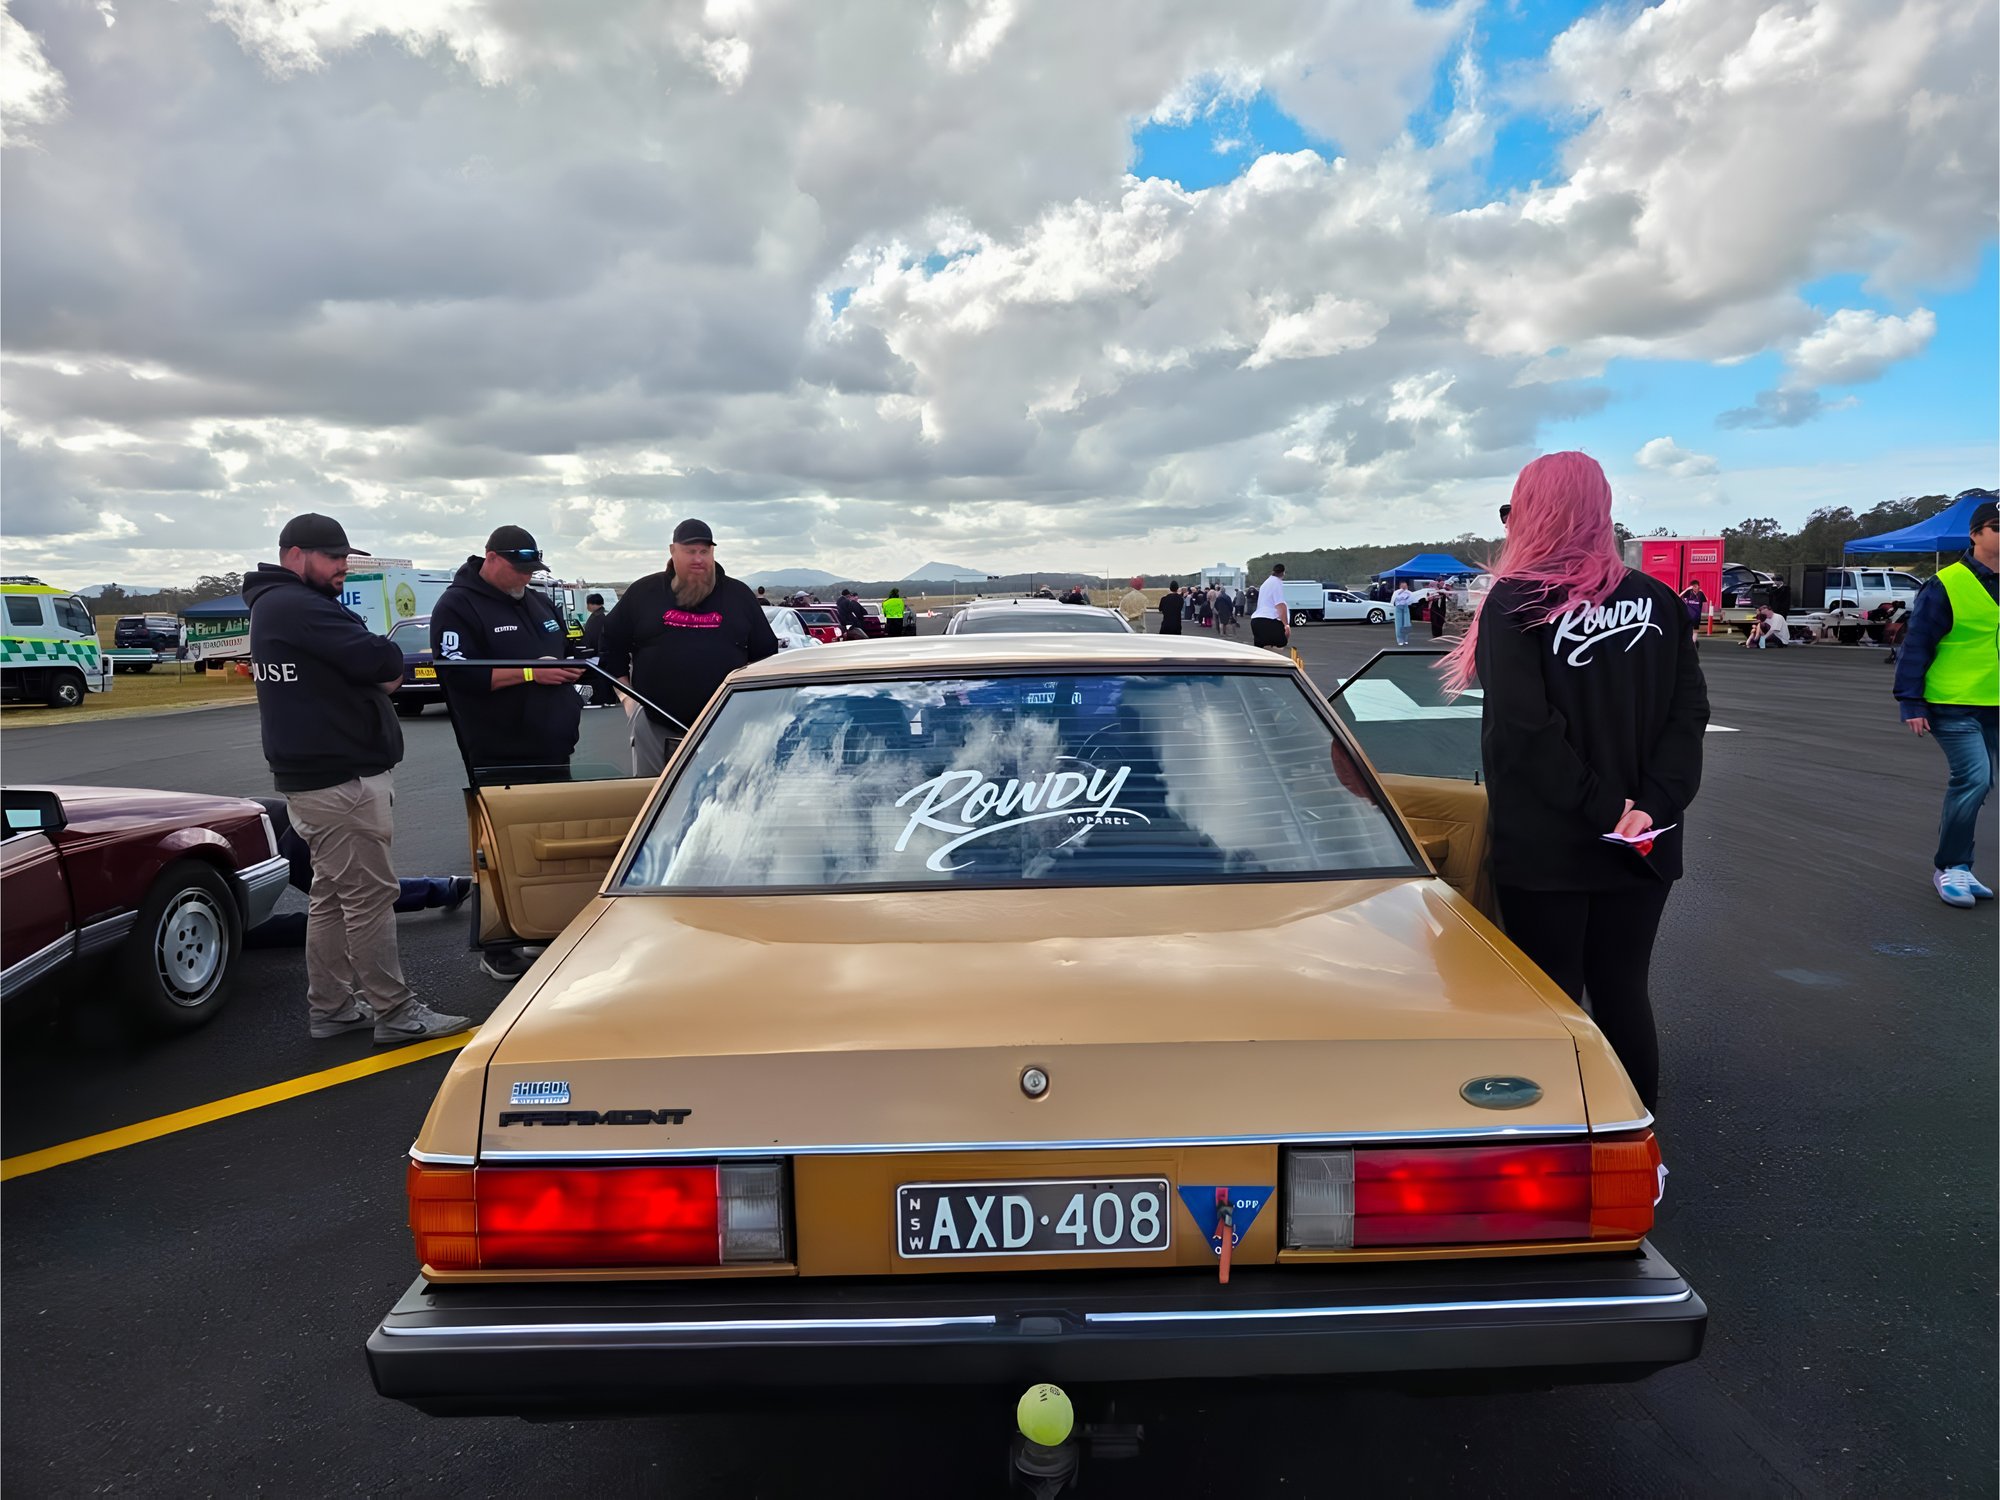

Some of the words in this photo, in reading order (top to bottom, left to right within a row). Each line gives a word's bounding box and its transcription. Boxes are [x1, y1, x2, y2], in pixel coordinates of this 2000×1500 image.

[252, 662, 298, 682] USE
[1067, 816, 1130, 826] APPAREL
[512, 1081, 570, 1097] SHITBOX
